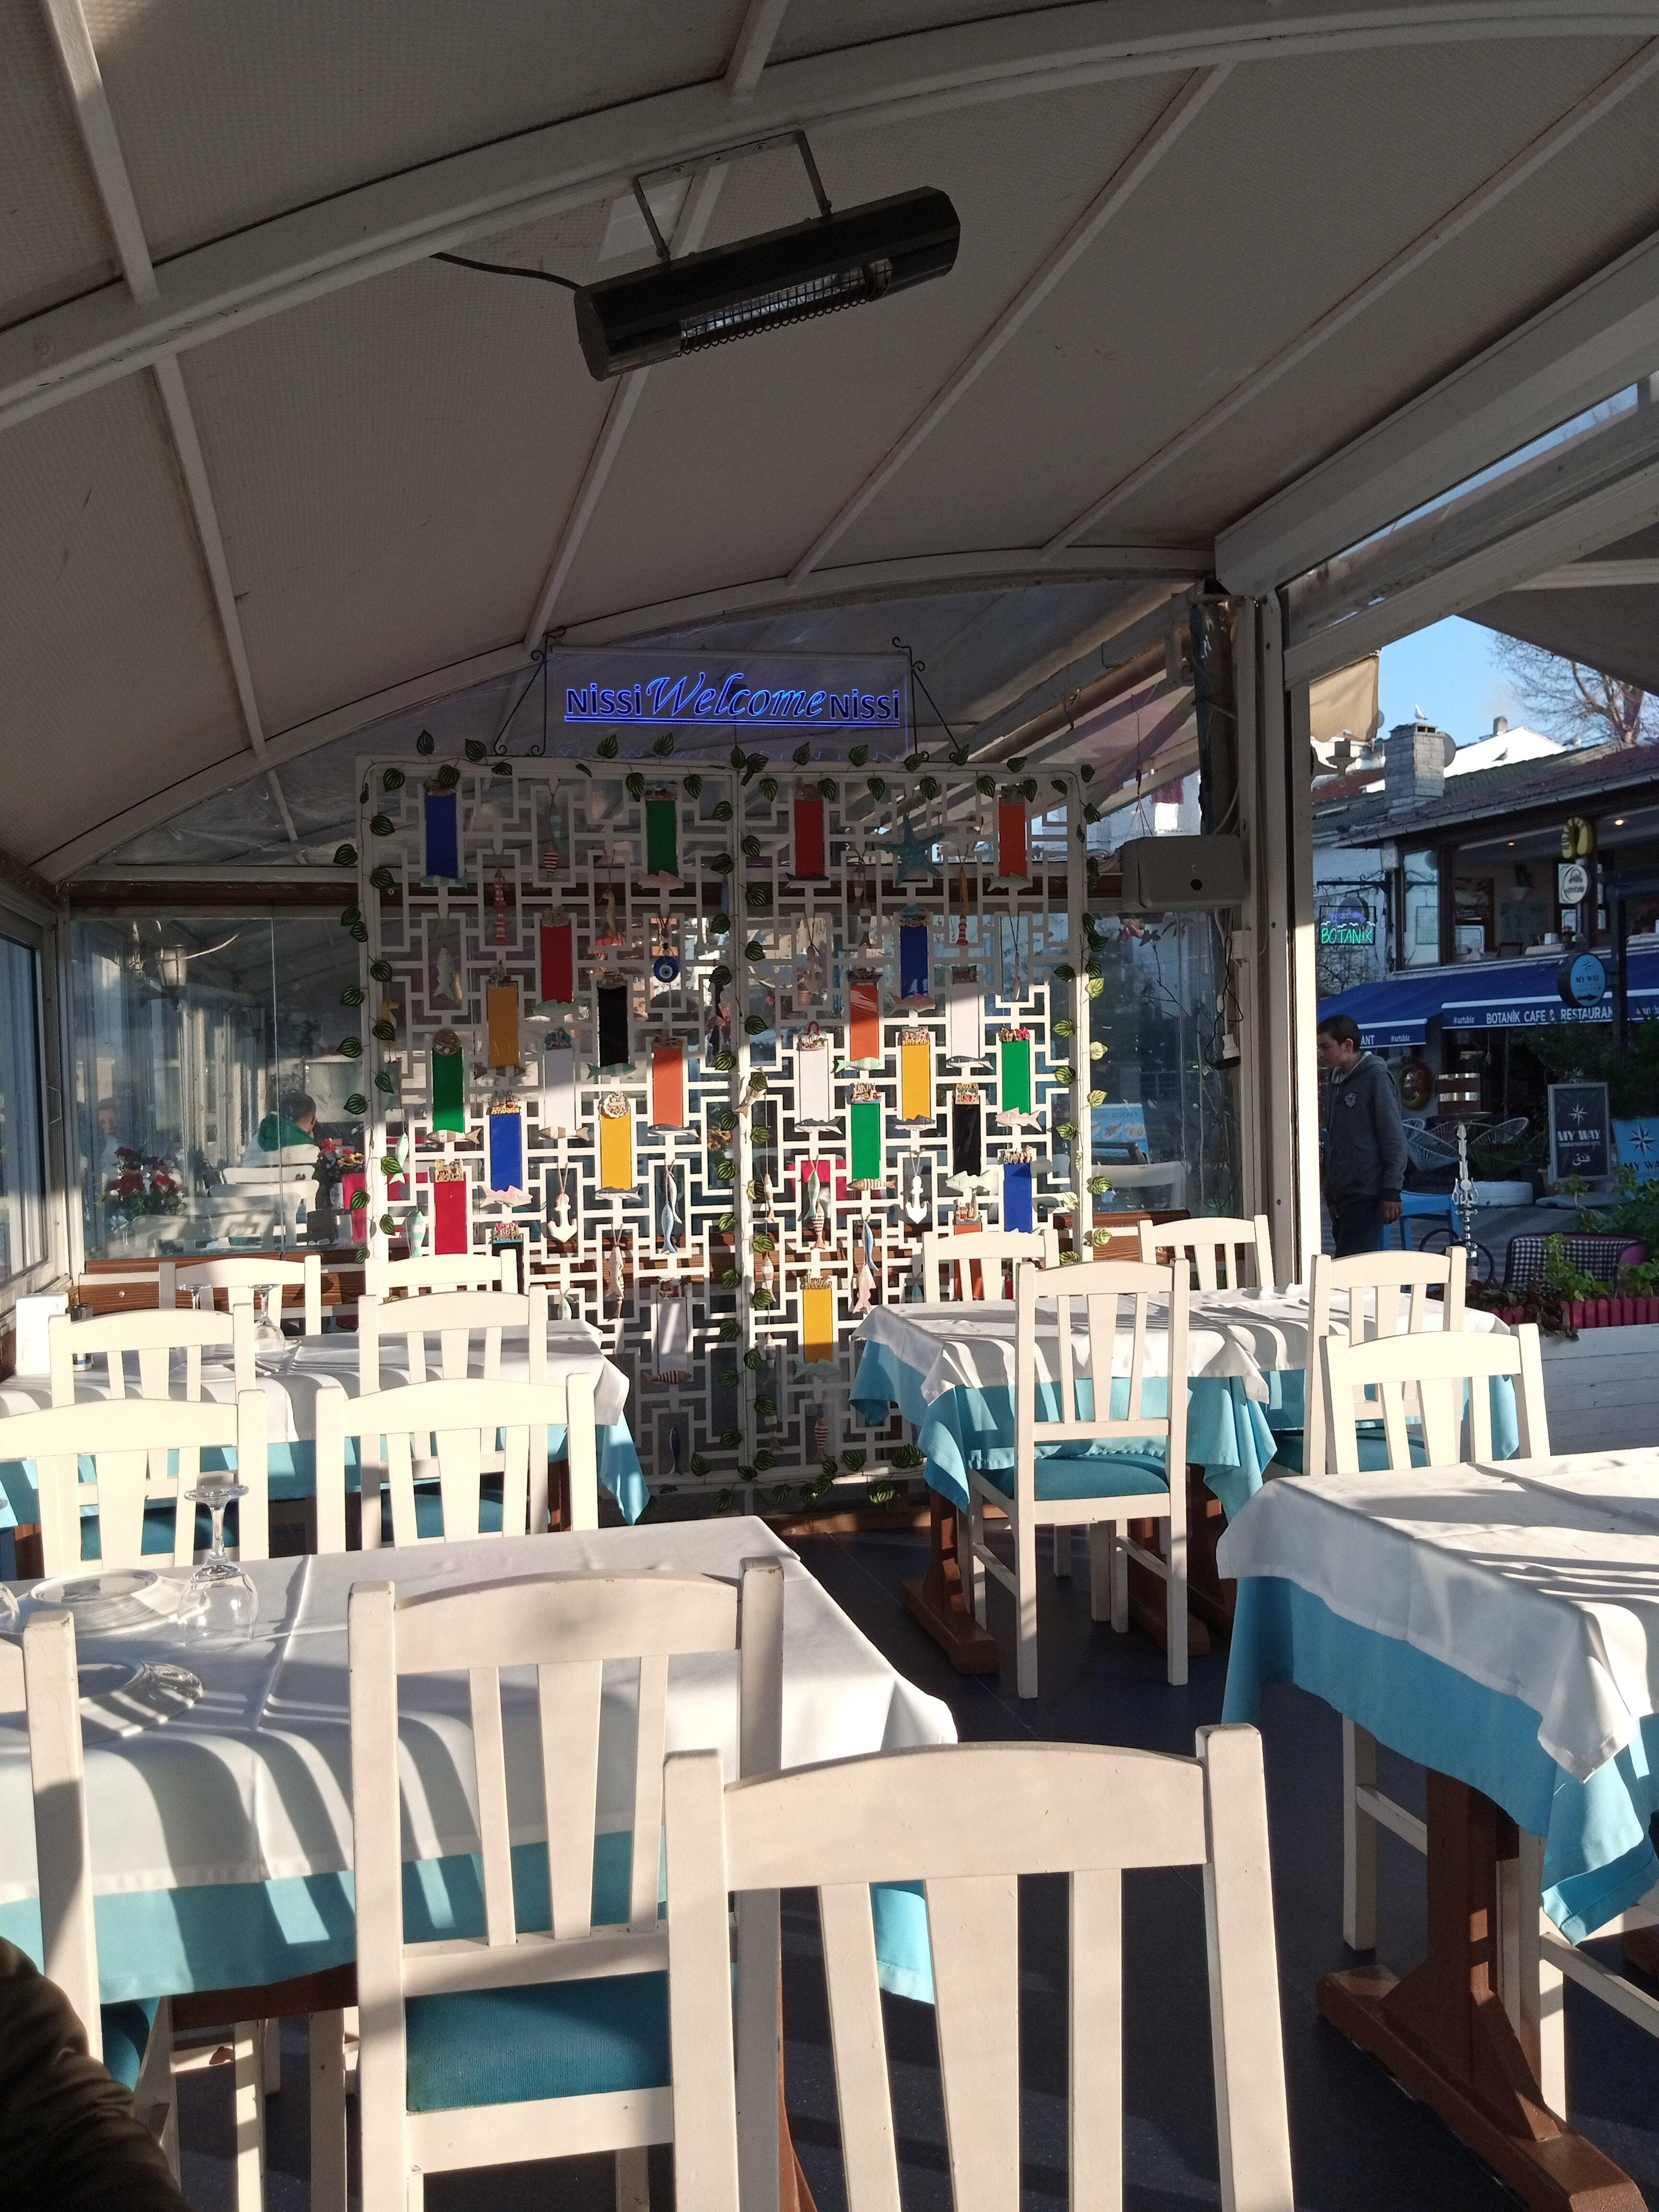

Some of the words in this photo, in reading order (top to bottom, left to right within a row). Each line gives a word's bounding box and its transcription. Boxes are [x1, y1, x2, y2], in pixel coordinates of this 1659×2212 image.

[646, 672, 827, 717] Welcome
[1486, 1010, 1520, 1024] BOTANİK
[1524, 1009, 1546, 1022] CAFE
[1560, 1006, 1613, 1021] RESTAURAN
[1360, 1034, 1375, 1046] ANT
[1557, 1130, 1575, 1142] MY
[1577, 1129, 1601, 1141] WAY
